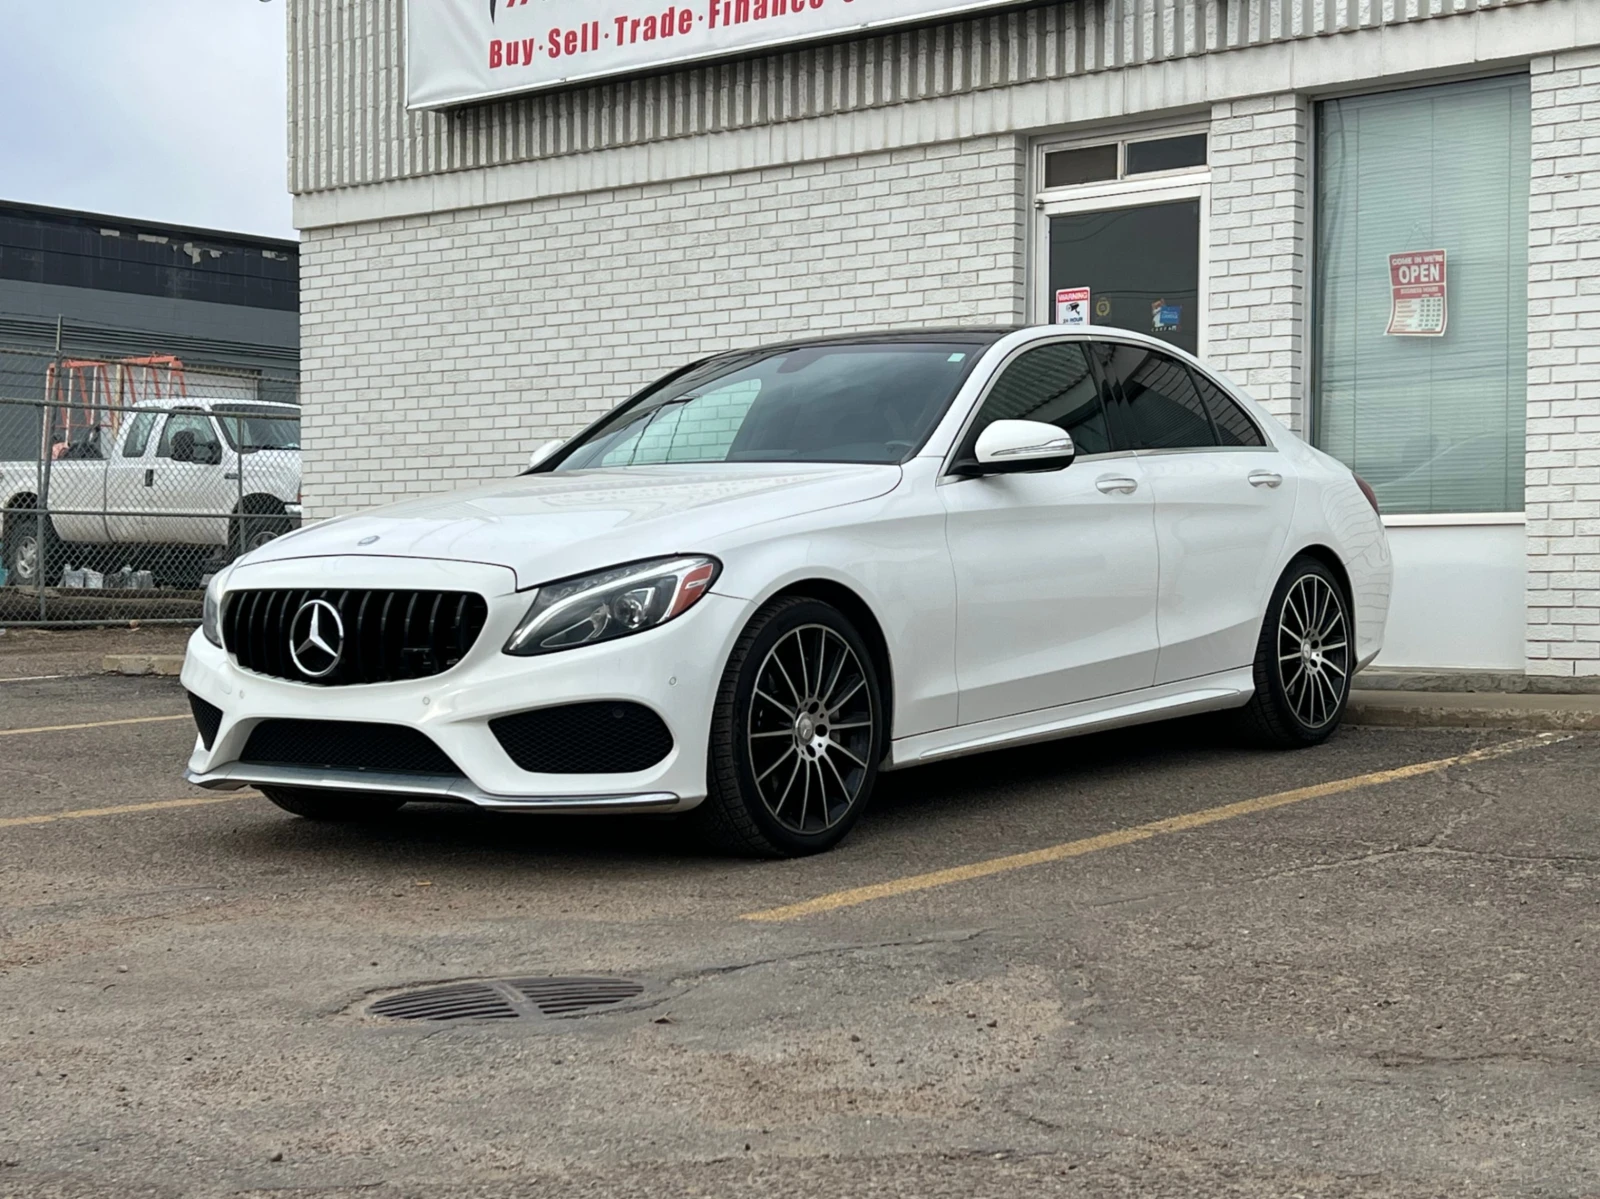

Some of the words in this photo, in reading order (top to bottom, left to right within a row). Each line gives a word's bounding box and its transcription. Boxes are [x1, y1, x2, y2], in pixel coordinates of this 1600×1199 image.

[488, 38, 535, 69] Buy
[547, 21, 599, 59] Sell
[614, 6, 693, 47] Trade
[1414, 256, 1422, 264] IN
[1399, 263, 1439, 283] OPEN
